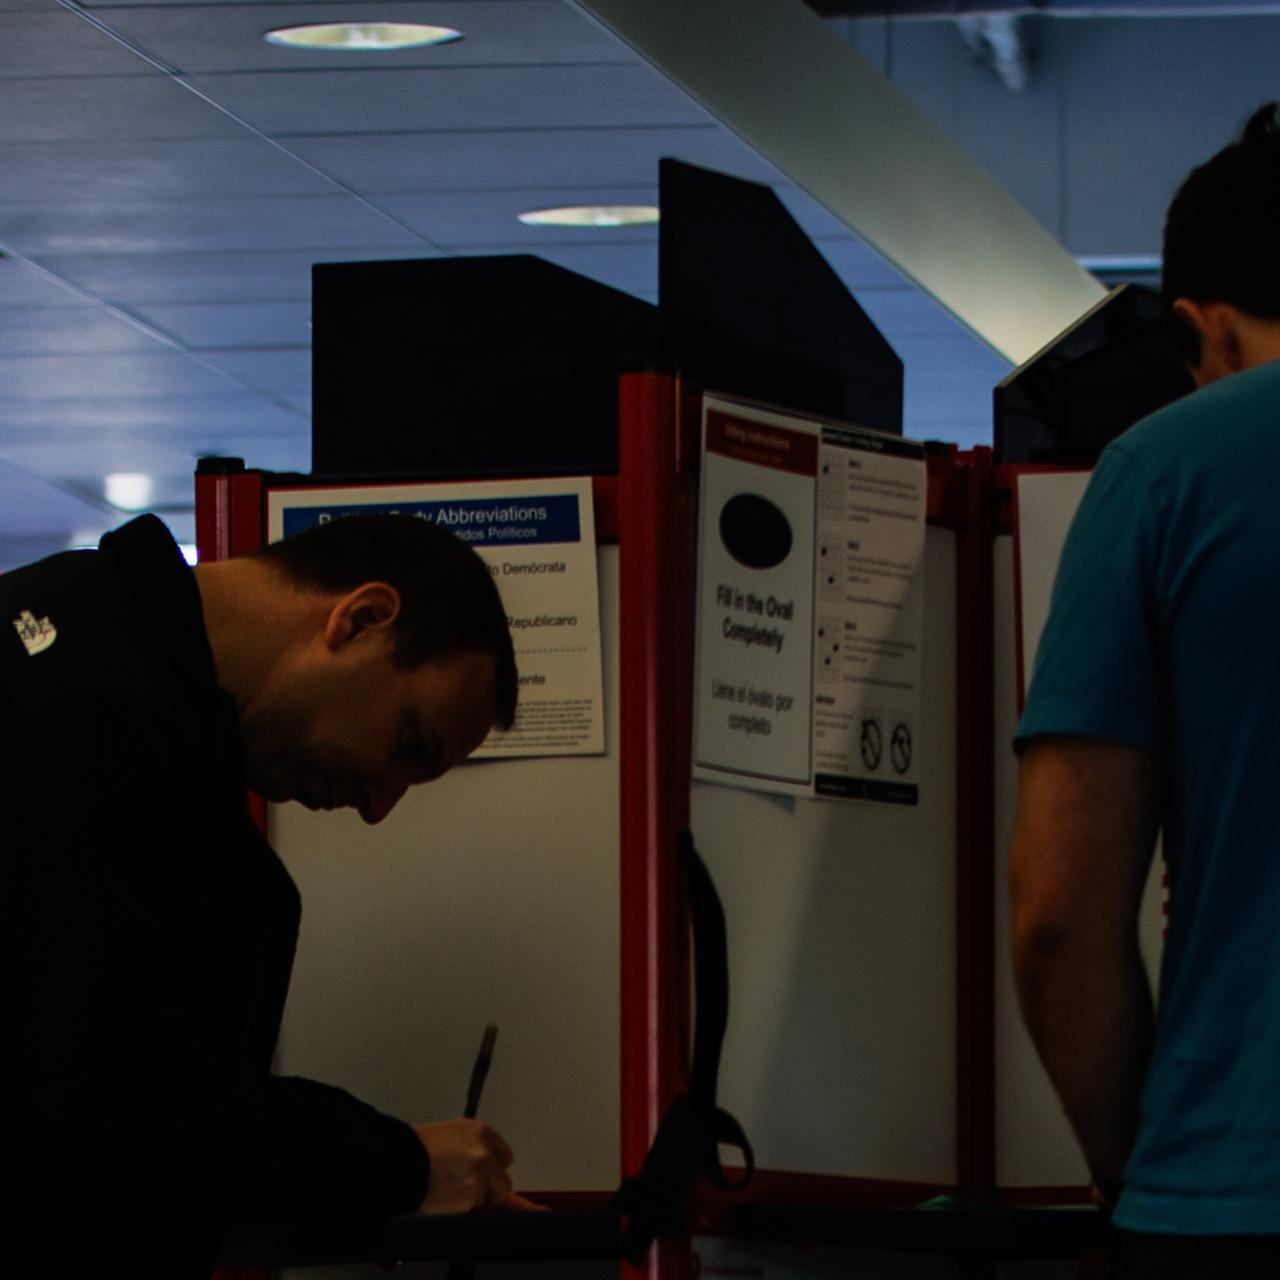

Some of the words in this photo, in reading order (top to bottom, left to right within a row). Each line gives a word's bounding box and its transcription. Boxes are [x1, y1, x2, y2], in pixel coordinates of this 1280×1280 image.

[435, 505, 548, 525] Abbreviations
[502, 561, 566, 576] Demócrata
[717, 584, 732, 607] Fill
[734, 590, 744, 611] in
[746, 592, 764, 615] the
[766, 595, 793, 621] Oval
[723, 616, 784, 655] Completely
